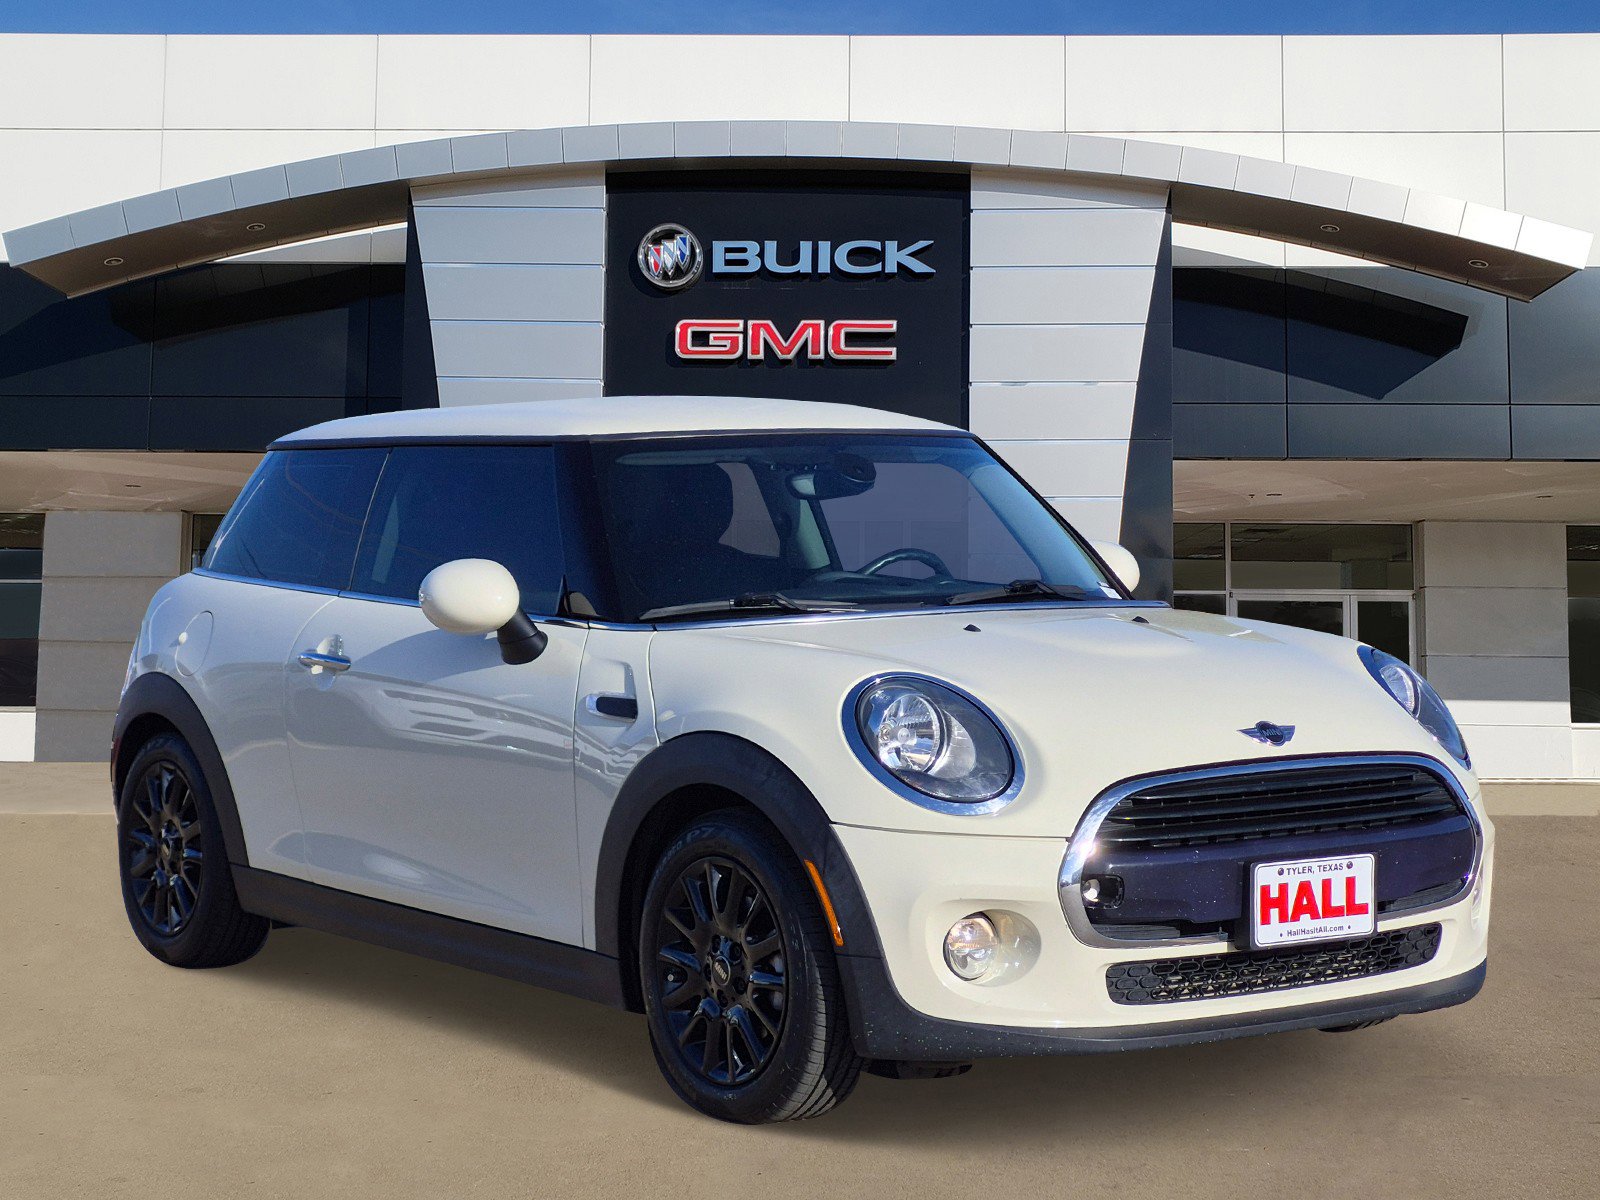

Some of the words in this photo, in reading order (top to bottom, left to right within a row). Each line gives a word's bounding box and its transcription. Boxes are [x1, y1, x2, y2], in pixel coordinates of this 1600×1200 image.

[712, 240, 936, 274] BUICK
[674, 319, 898, 361] GMC
[1286, 866, 1315, 876] TYLER,
[1317, 862, 1344, 873] TEXAS
[1260, 876, 1369, 926] HALL
[1286, 925, 1344, 938] HallHasItAll.com
